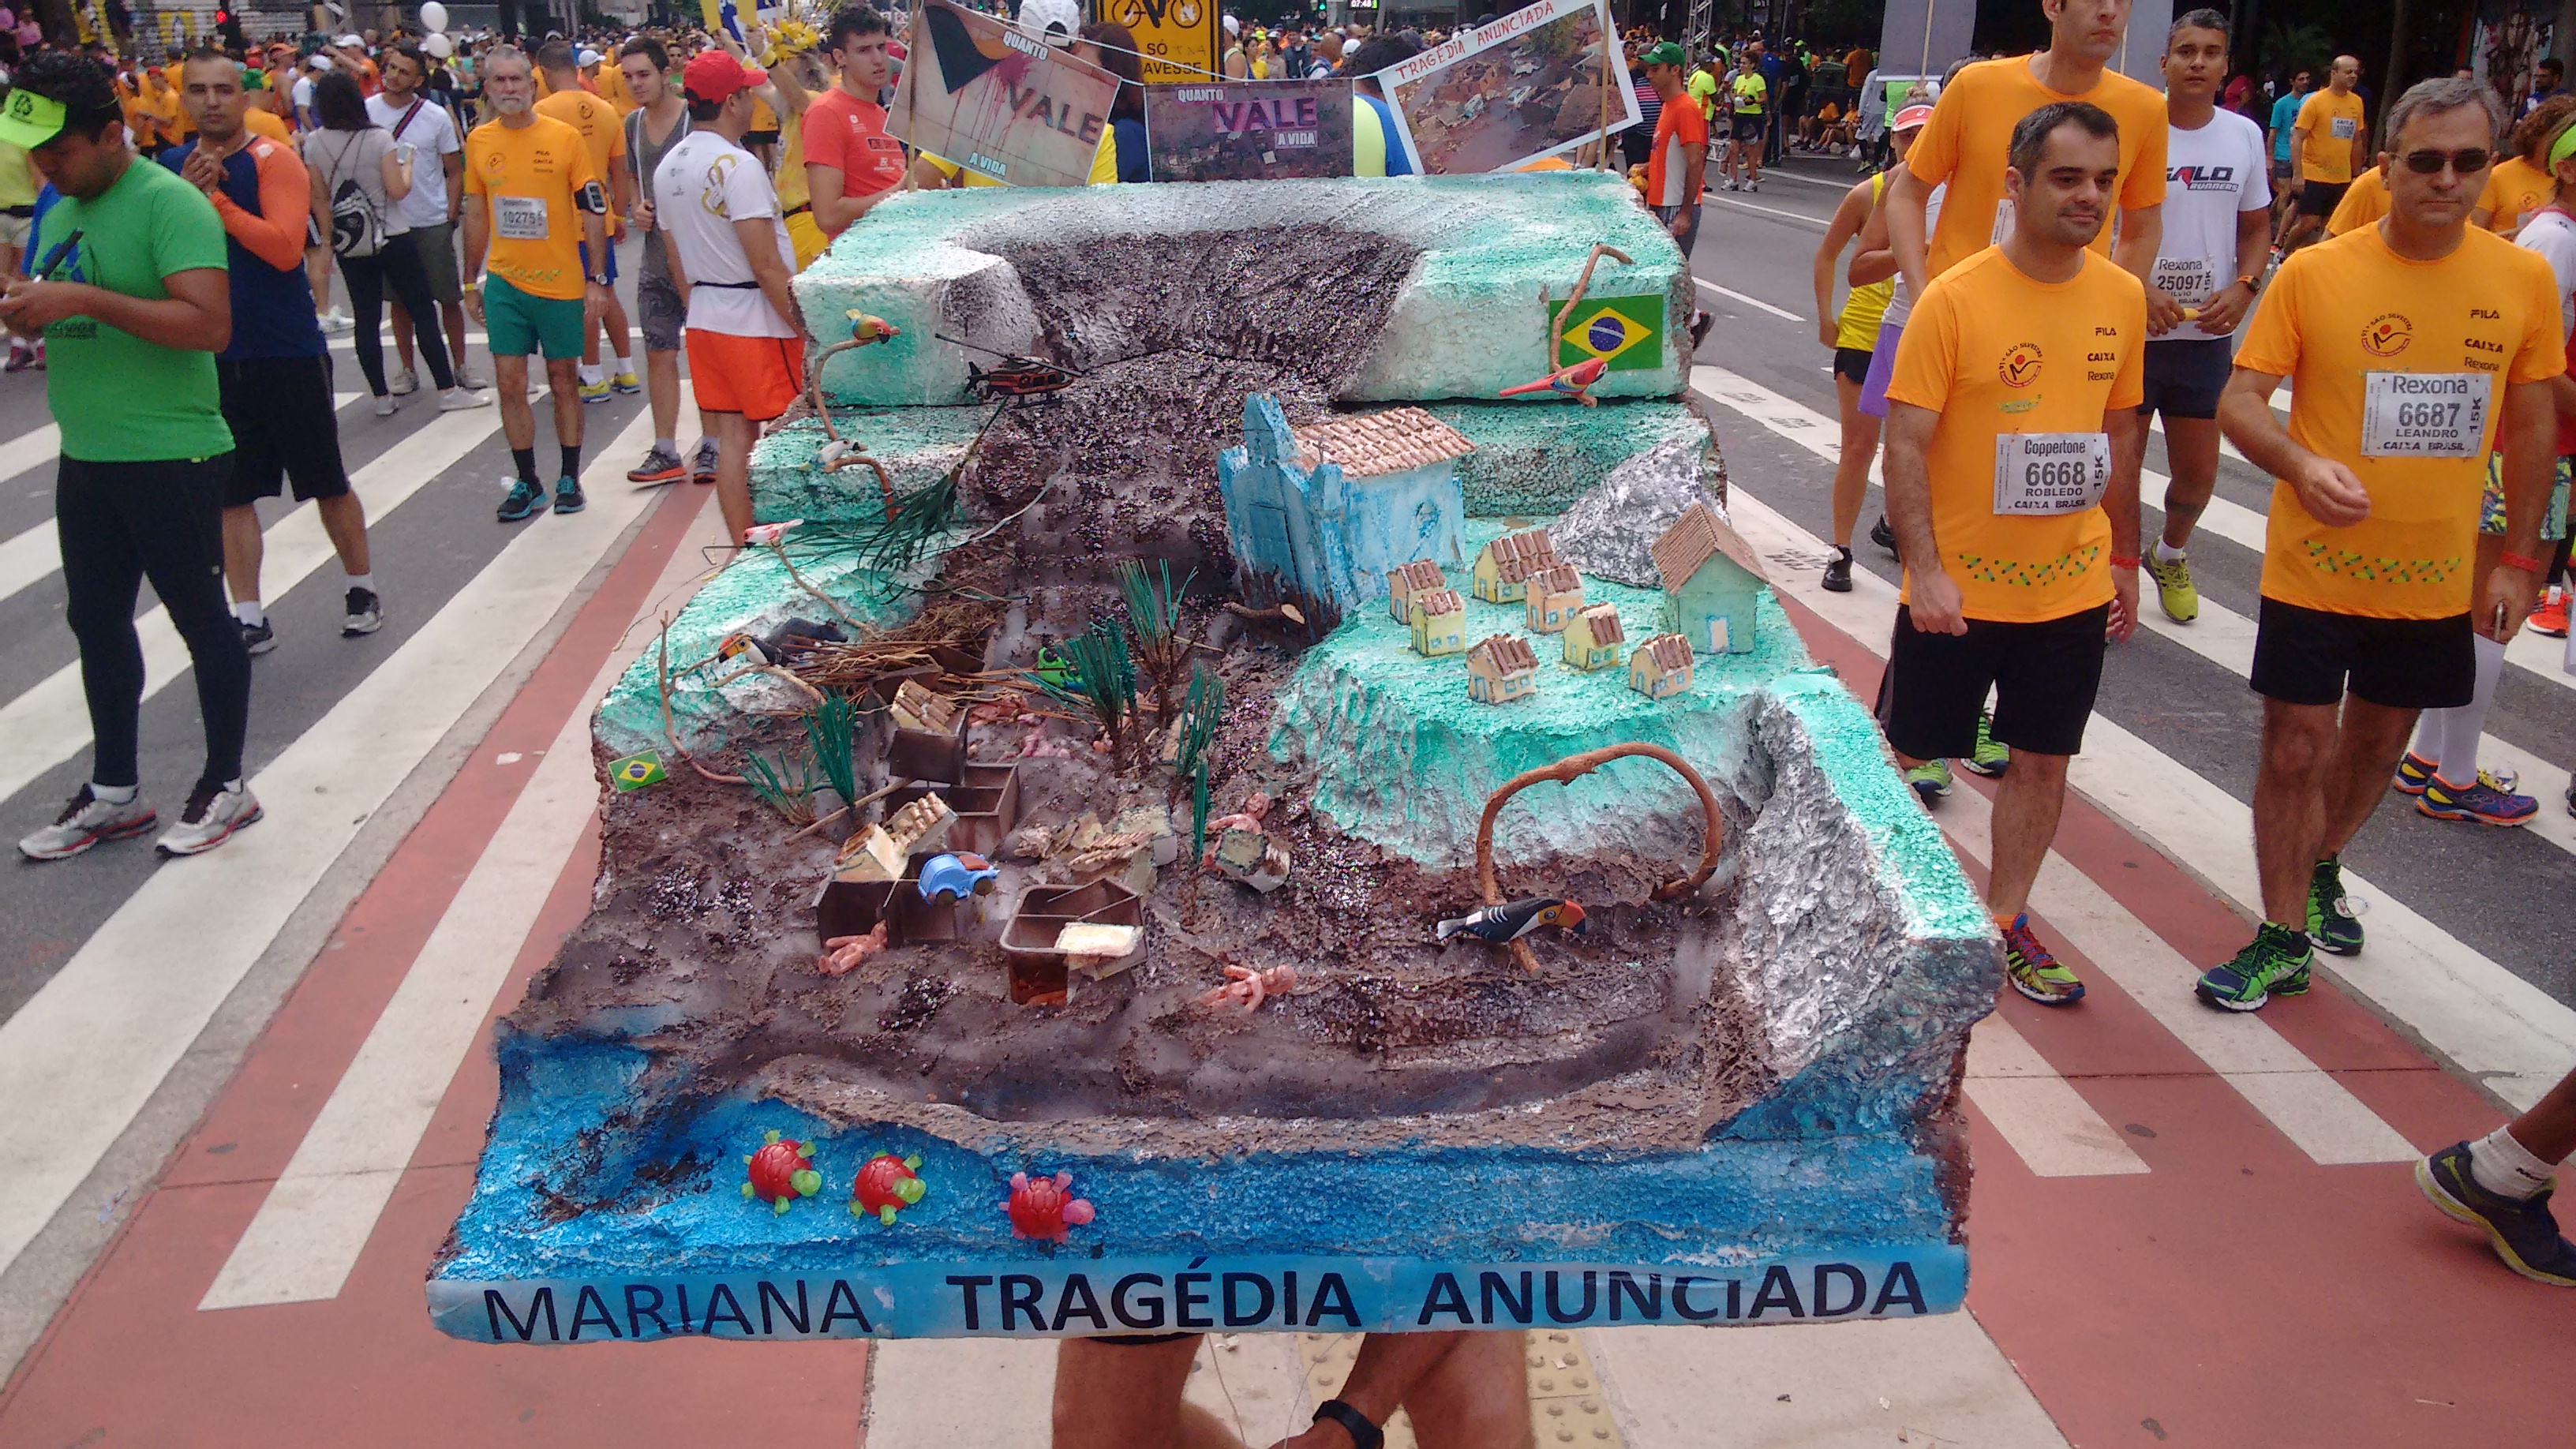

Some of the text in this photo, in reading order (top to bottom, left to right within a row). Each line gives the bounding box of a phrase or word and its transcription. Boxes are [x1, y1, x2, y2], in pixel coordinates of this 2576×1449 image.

[1002, 31, 1049, 61] QUANTO
[1147, 39, 1168, 55] SÓ
[1144, 62, 1202, 74] AVESSE
[1178, 88, 1224, 103] QUANTO
[1008, 79, 1103, 144] VALE
[1212, 97, 1316, 132] VALE
[1278, 132, 1316, 146] A VIDA
[969, 152, 1007, 176] A VIDA
[2189, 182, 2238, 192] RUNNERS
[504, 211, 536, 224] 10275
[2159, 259, 2203, 271] Rexona
[2158, 275, 2203, 290] 25097
[2470, 309, 2500, 319] FILA
[2095, 328, 2117, 336] FILA
[2464, 338, 2503, 353] CAIXA
[2087, 353, 2115, 361] CAIXA
[2464, 357, 2499, 372] Rexona
[2087, 371, 2115, 381] Rexona
[2392, 375, 2468, 394] Rexona
[2398, 402, 2461, 427] 6687
[2469, 396, 2482, 433] 15K
[2396, 429, 2458, 438] LEANDRO
[2025, 439, 2085, 457] Coppertone
[2383, 441, 2465, 451] CAIXA BRASIL
[2025, 462, 2086, 486] 6668
[2093, 455, 2103, 490] 15K
[2025, 488, 2083, 496] ROBLEDO
[2055, 499, 2086, 508] BRASIL
[483, 1256, 1928, 1342] MARIANA TRAGÉDIA ANUNCIADA
